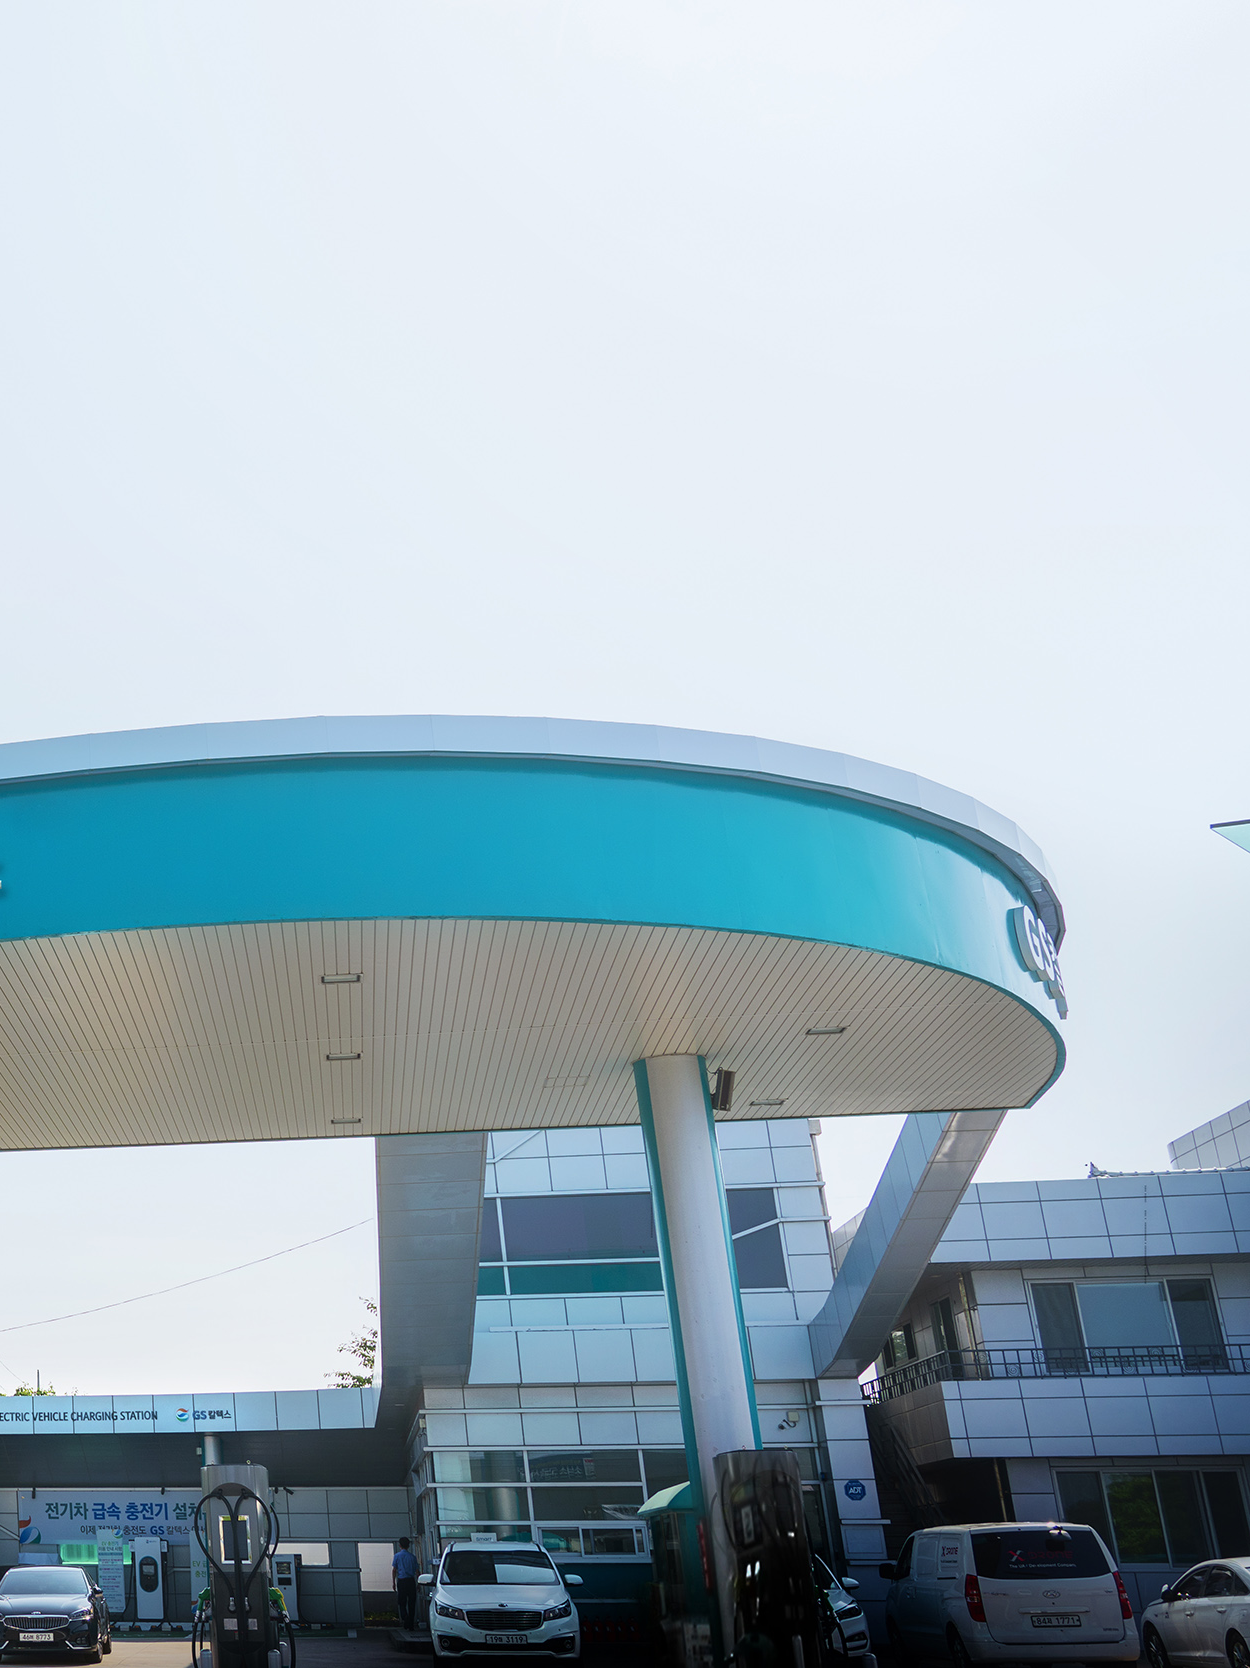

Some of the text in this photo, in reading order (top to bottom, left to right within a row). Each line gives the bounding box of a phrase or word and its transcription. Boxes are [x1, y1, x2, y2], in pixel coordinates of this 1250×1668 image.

[1018, 905, 1056, 982] GS
[32, 1411, 69, 1422] VEHICLE
[71, 1410, 118, 1421] CHARGING
[120, 1410, 158, 1421] STATION
[192, 1410, 232, 1420] GS 칼텍스
[848, 1486, 862, 1494] ADT
[45, 1502, 88, 1521] 전기차
[91, 1502, 121, 1521] 급속
[125, 1502, 169, 1521] 충전기
[80, 1525, 95, 1535] 이제
[123, 1525, 147, 1536] 충전도
[150, 1526, 164, 1535] GS
[166, 1525, 190, 1535] 칼텍스
[1027, 1550, 1074, 1560] DRONE
[1055, 1616, 1075, 1625] 1771
[35, 1633, 51, 1641] 8773
[505, 1635, 524, 1643] 3119
